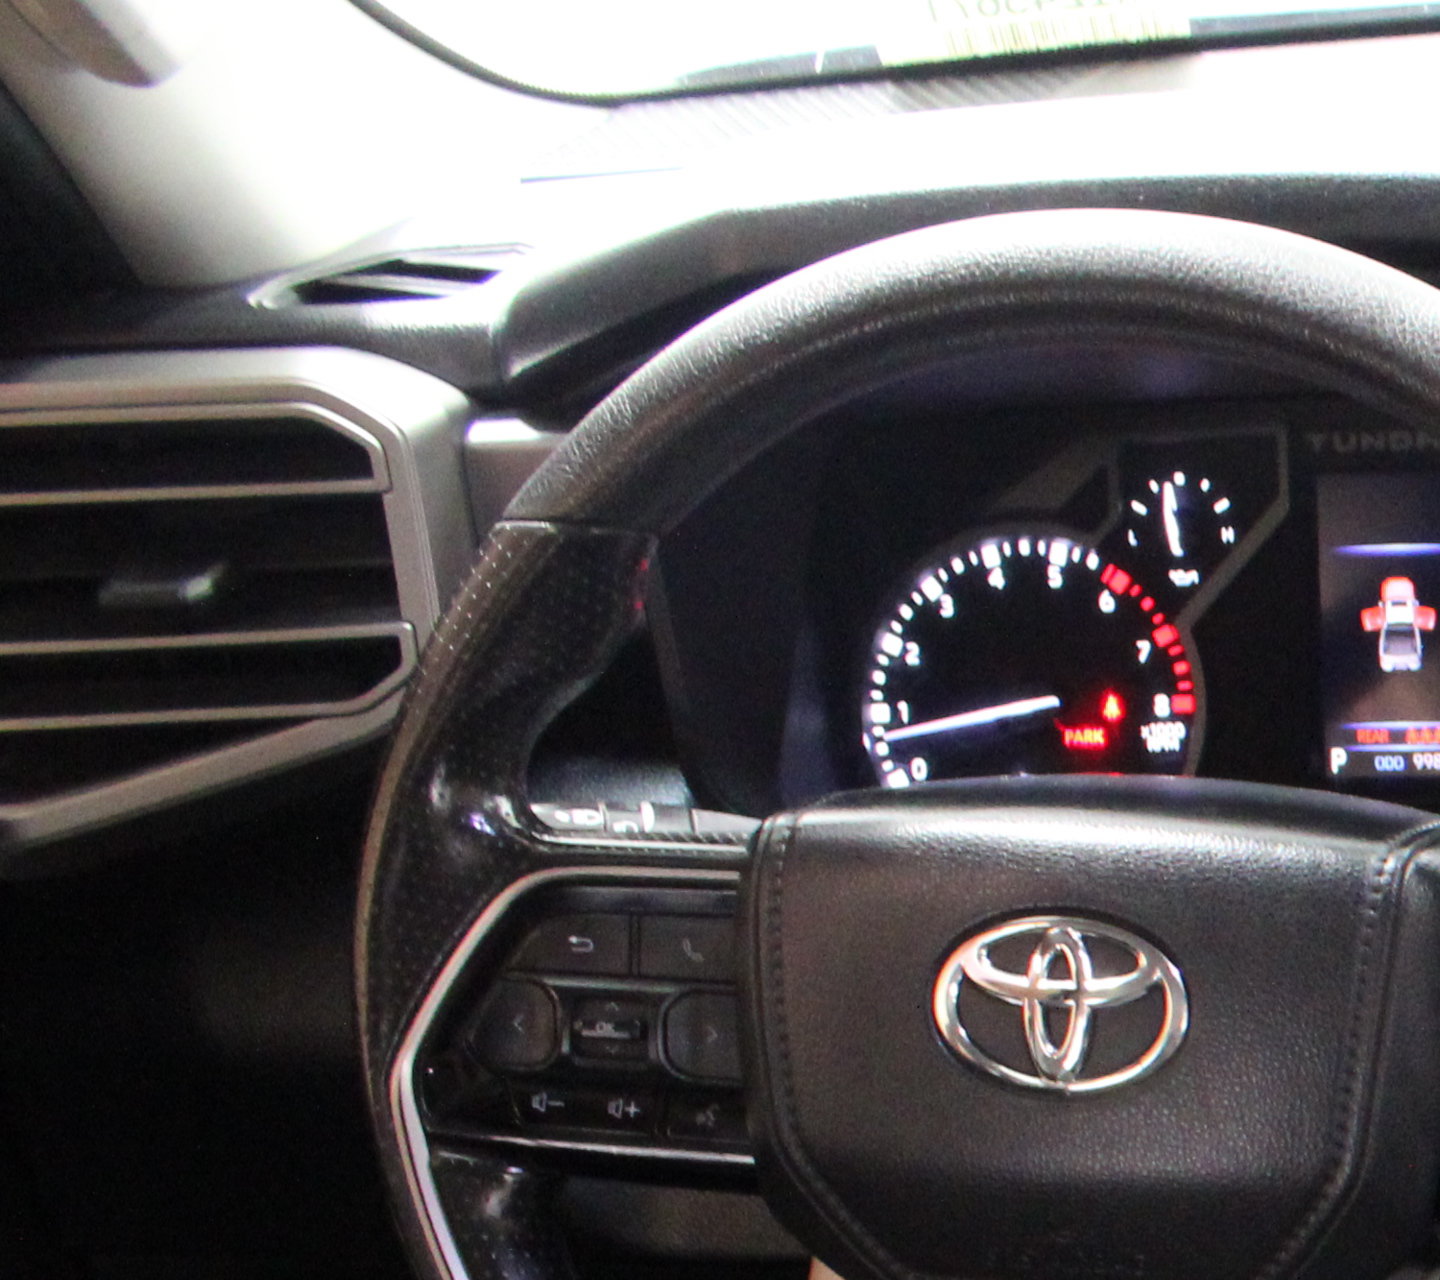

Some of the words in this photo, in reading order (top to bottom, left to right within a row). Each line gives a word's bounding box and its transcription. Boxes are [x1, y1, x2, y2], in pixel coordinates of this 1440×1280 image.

[987, 567, 1006, 590] 4
[1046, 565, 1063, 589] 5
[939, 593, 955, 618] 3
[1097, 589, 1116, 613] 6
[904, 641, 920, 666] 2
[1135, 639, 1152, 664] 7
[896, 700, 910, 724] 1
[1153, 692, 1171, 718] 8
[1064, 727, 1105, 745] PARK
[910, 757, 928, 781] 0
[1330, 746, 1347, 775] P
